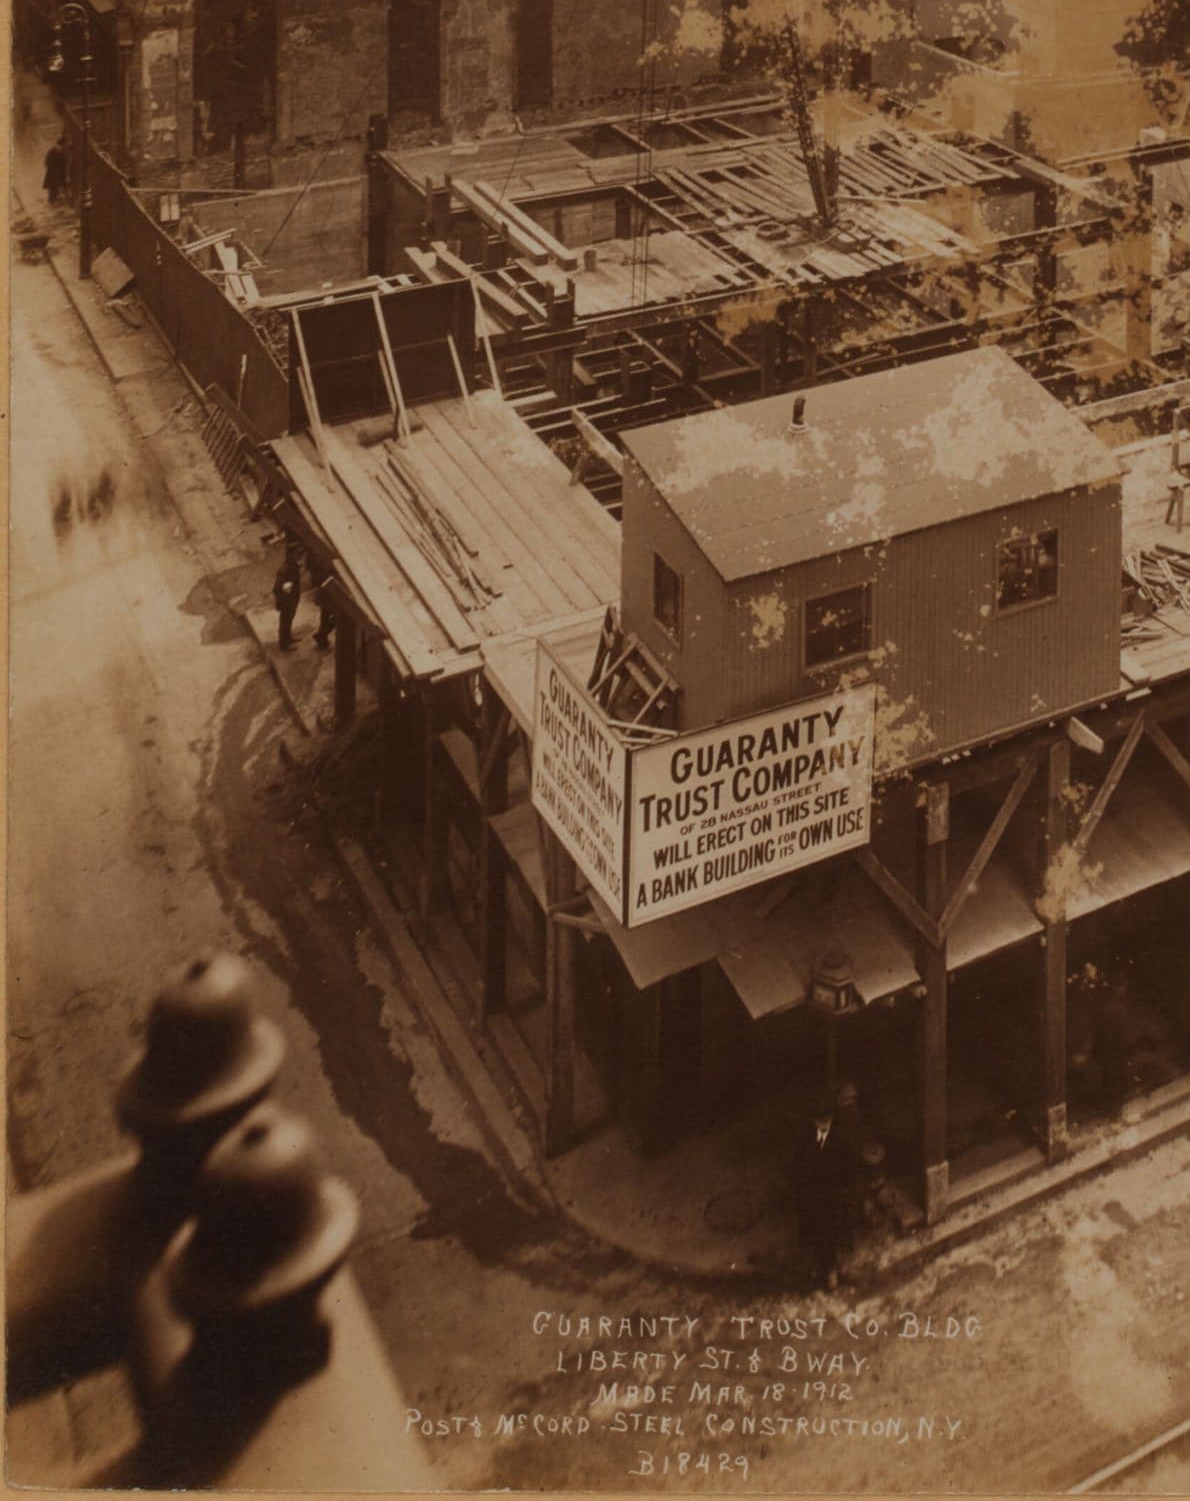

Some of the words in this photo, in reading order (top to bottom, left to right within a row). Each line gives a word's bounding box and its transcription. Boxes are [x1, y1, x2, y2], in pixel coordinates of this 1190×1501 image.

[548, 667, 614, 773] GUARANTY
[540, 691, 570, 758] TRUST
[573, 734, 622, 826] COMPANY
[670, 706, 844, 784] GUARANTY
[639, 781, 725, 832] TRUST
[732, 736, 865, 803] COMPANY
[653, 840, 692, 870] WILL
[697, 822, 746, 856] ERECT
[750, 809, 772, 837] ON
[777, 799, 810, 827] THIS
[813, 787, 850, 815] SITE
[680, 824, 696, 836] OF
[701, 816, 717, 830] 28
[720, 802, 768, 822] NASSAU
[773, 782, 822, 806] STREET
[836, 806, 865, 837] USE
[778, 831, 797, 845] FOR
[779, 844, 795, 858] ITS
[799, 817, 833, 851] OWN
[652, 863, 698, 902] BANK
[703, 838, 776, 885] BUILDING
[636, 882, 648, 909] A
